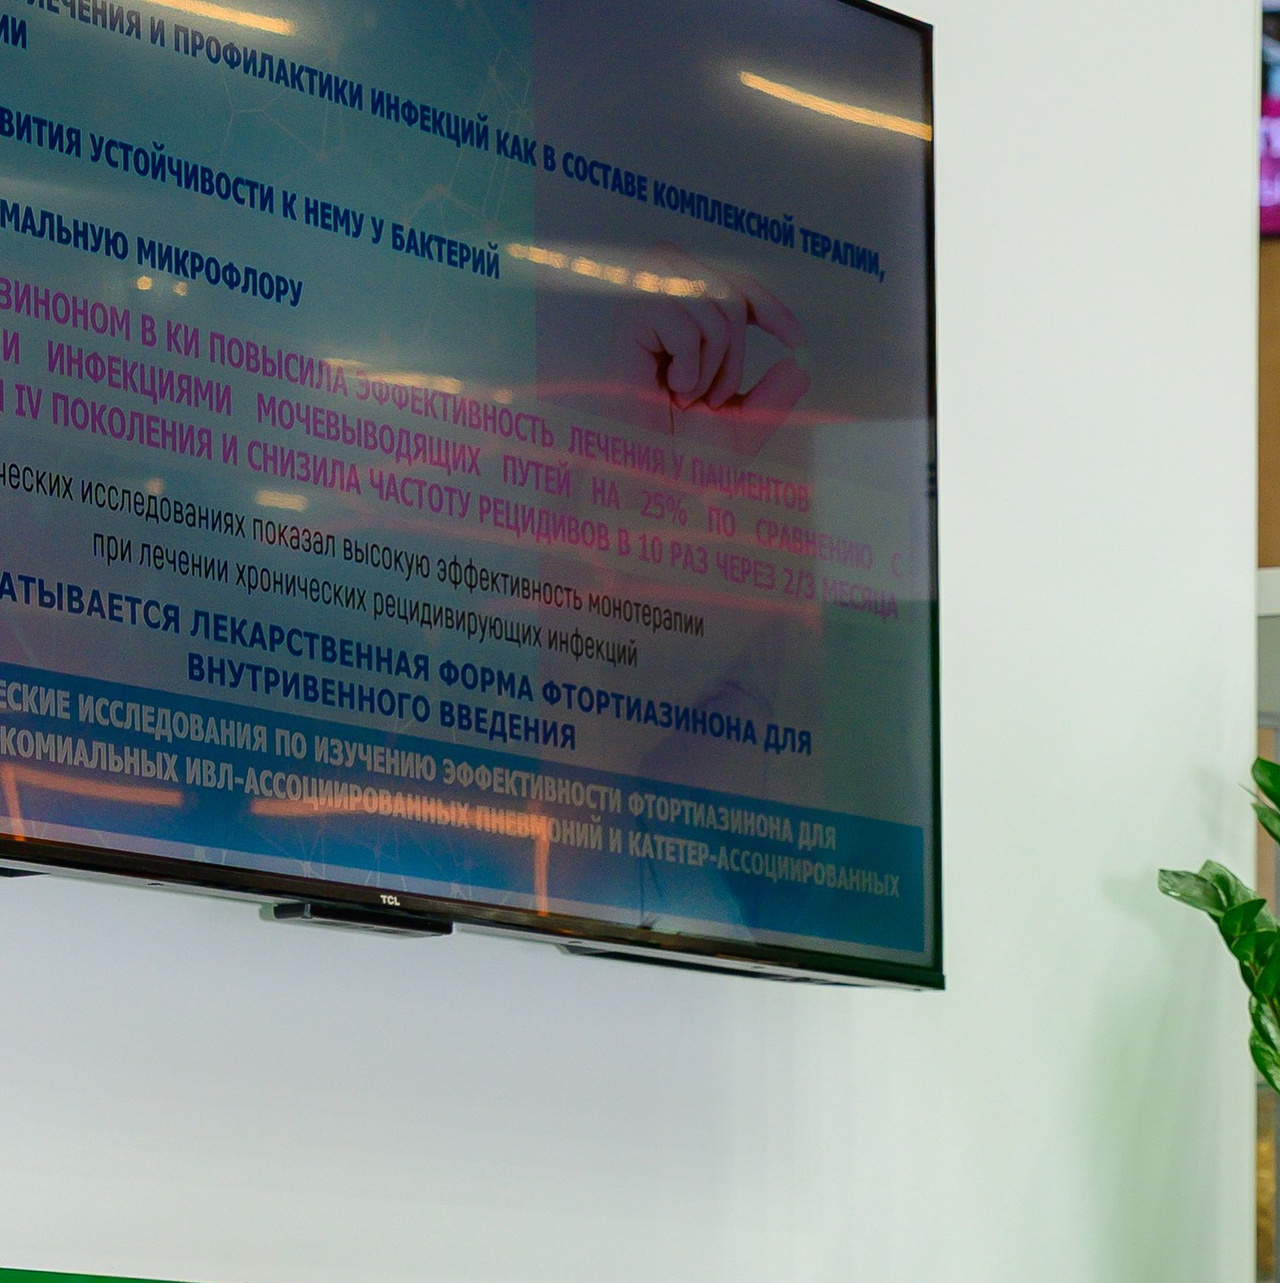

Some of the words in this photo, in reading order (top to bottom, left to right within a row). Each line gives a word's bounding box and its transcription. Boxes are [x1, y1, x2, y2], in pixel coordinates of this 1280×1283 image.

[0, 106, 81, 158] ВИТИЯ
[89, 132, 274, 213] УСТОЙЧИВОСТИ
[282, 190, 297, 220] К
[304, 197, 364, 238] НЕМУ
[370, 216, 384, 245] У
[392, 224, 500, 279] БАКТЕРИЙ
[150, 16, 166, 46] И
[174, 24, 363, 110] ПРОФИЛАКТИКИ
[371, 88, 489, 151] ИНФЕКЦИЙ
[496, 130, 537, 166] КАК
[543, 144, 556, 171] В
[562, 152, 647, 200] СОСТАВЕ
[654, 181, 795, 249] КОМПЛЕКСНОЙ
[799, 227, 886, 282] ТЕРАПИИ,
[0, 199, 128, 260] МАЛЬНУЮ
[137, 236, 303, 308] МИКРОФЛОРУ
[3, 329, 20, 365] И
[47, 340, 233, 417] ИНФЕКЦИЯМИ
[256, 393, 482, 476] МОЧЕВЫВОДЯЩИХ
[502, 454, 572, 499] ПУТЕЙ
[592, 476, 620, 510] НА
[640, 490, 689, 526] 25%
[708, 506, 737, 538] ПО
[755, 518, 874, 573] СРАВНЕНИЮ
[141, 313, 156, 347] В
[166, 326, 200, 359] КИ
[209, 331, 348, 399] ПОВЫСИЛА
[355, 370, 555, 448] ЭФФЕКТИВНОСТЬ
[568, 425, 666, 476] ЛЕЧЕНИЯ
[671, 453, 685, 481] У
[690, 460, 811, 513] ПАЦИЕНТОВ
[14, 384, 43, 420] IV
[52, 393, 213, 462] ПОКОЛЕНИЯ
[221, 433, 239, 466] И
[247, 440, 362, 495] СНИЗИЛА
[369, 466, 471, 519] ЧАСТОТУ
[478, 494, 610, 551] РЕЦИДИВОВ
[617, 527, 631, 557] В
[638, 533, 664, 564] 10
[669, 540, 709, 576] РАЗ
[714, 549, 776, 593] ЧЕРЕЗ
[821, 576, 899, 623] МЕСЯЦА
[81, 478, 246, 539] исследованиях
[252, 516, 336, 558] показал
[343, 536, 431, 584] высокую
[436, 552, 583, 611] эффективность
[588, 591, 705, 638] монотерапии
[0, 570, 181, 634] АТЫВАЕТСЯ
[190, 610, 430, 683] ЛЕКАРСТВЕННАЯ
[438, 659, 533, 702] ФОРМА
[542, 680, 757, 746] ФТОРТИАЗИНОНА
[763, 723, 812, 756] ДЛЯ
[93, 532, 132, 566] при
[139, 543, 228, 584] лечении
[235, 561, 367, 613] хронических
[373, 593, 543, 648] рецидивирующих
[547, 626, 639, 669] инфекций
[78, 693, 267, 755] ИССЛЕДОВАНИЯ
[274, 728, 307, 760] ПО
[314, 735, 437, 783] ИЗУЧЕНИЮ
[442, 759, 622, 814] ЭФФЕКТИВНОСТИ
[628, 791, 795, 845] ФТОРТИАЗИНОНА
[798, 822, 837, 851] ДЛЯ
[187, 652, 431, 724] ВНУТРИВЕННОГО
[439, 701, 576, 751] ВВЕДЕНИЯ
[0, 725, 179, 783] КОМИАЛЬНЫХ
[185, 757, 470, 829] ИВЛ-АССОЦИИРОВАННЫХ
[476, 803, 603, 850] ПНЕВМОНИЙ
[609, 829, 622, 853] И
[628, 834, 900, 899] КАТЕТЕР-АССОЦИИРОВАННЫХ
[380, 894, 401, 907] TCL
